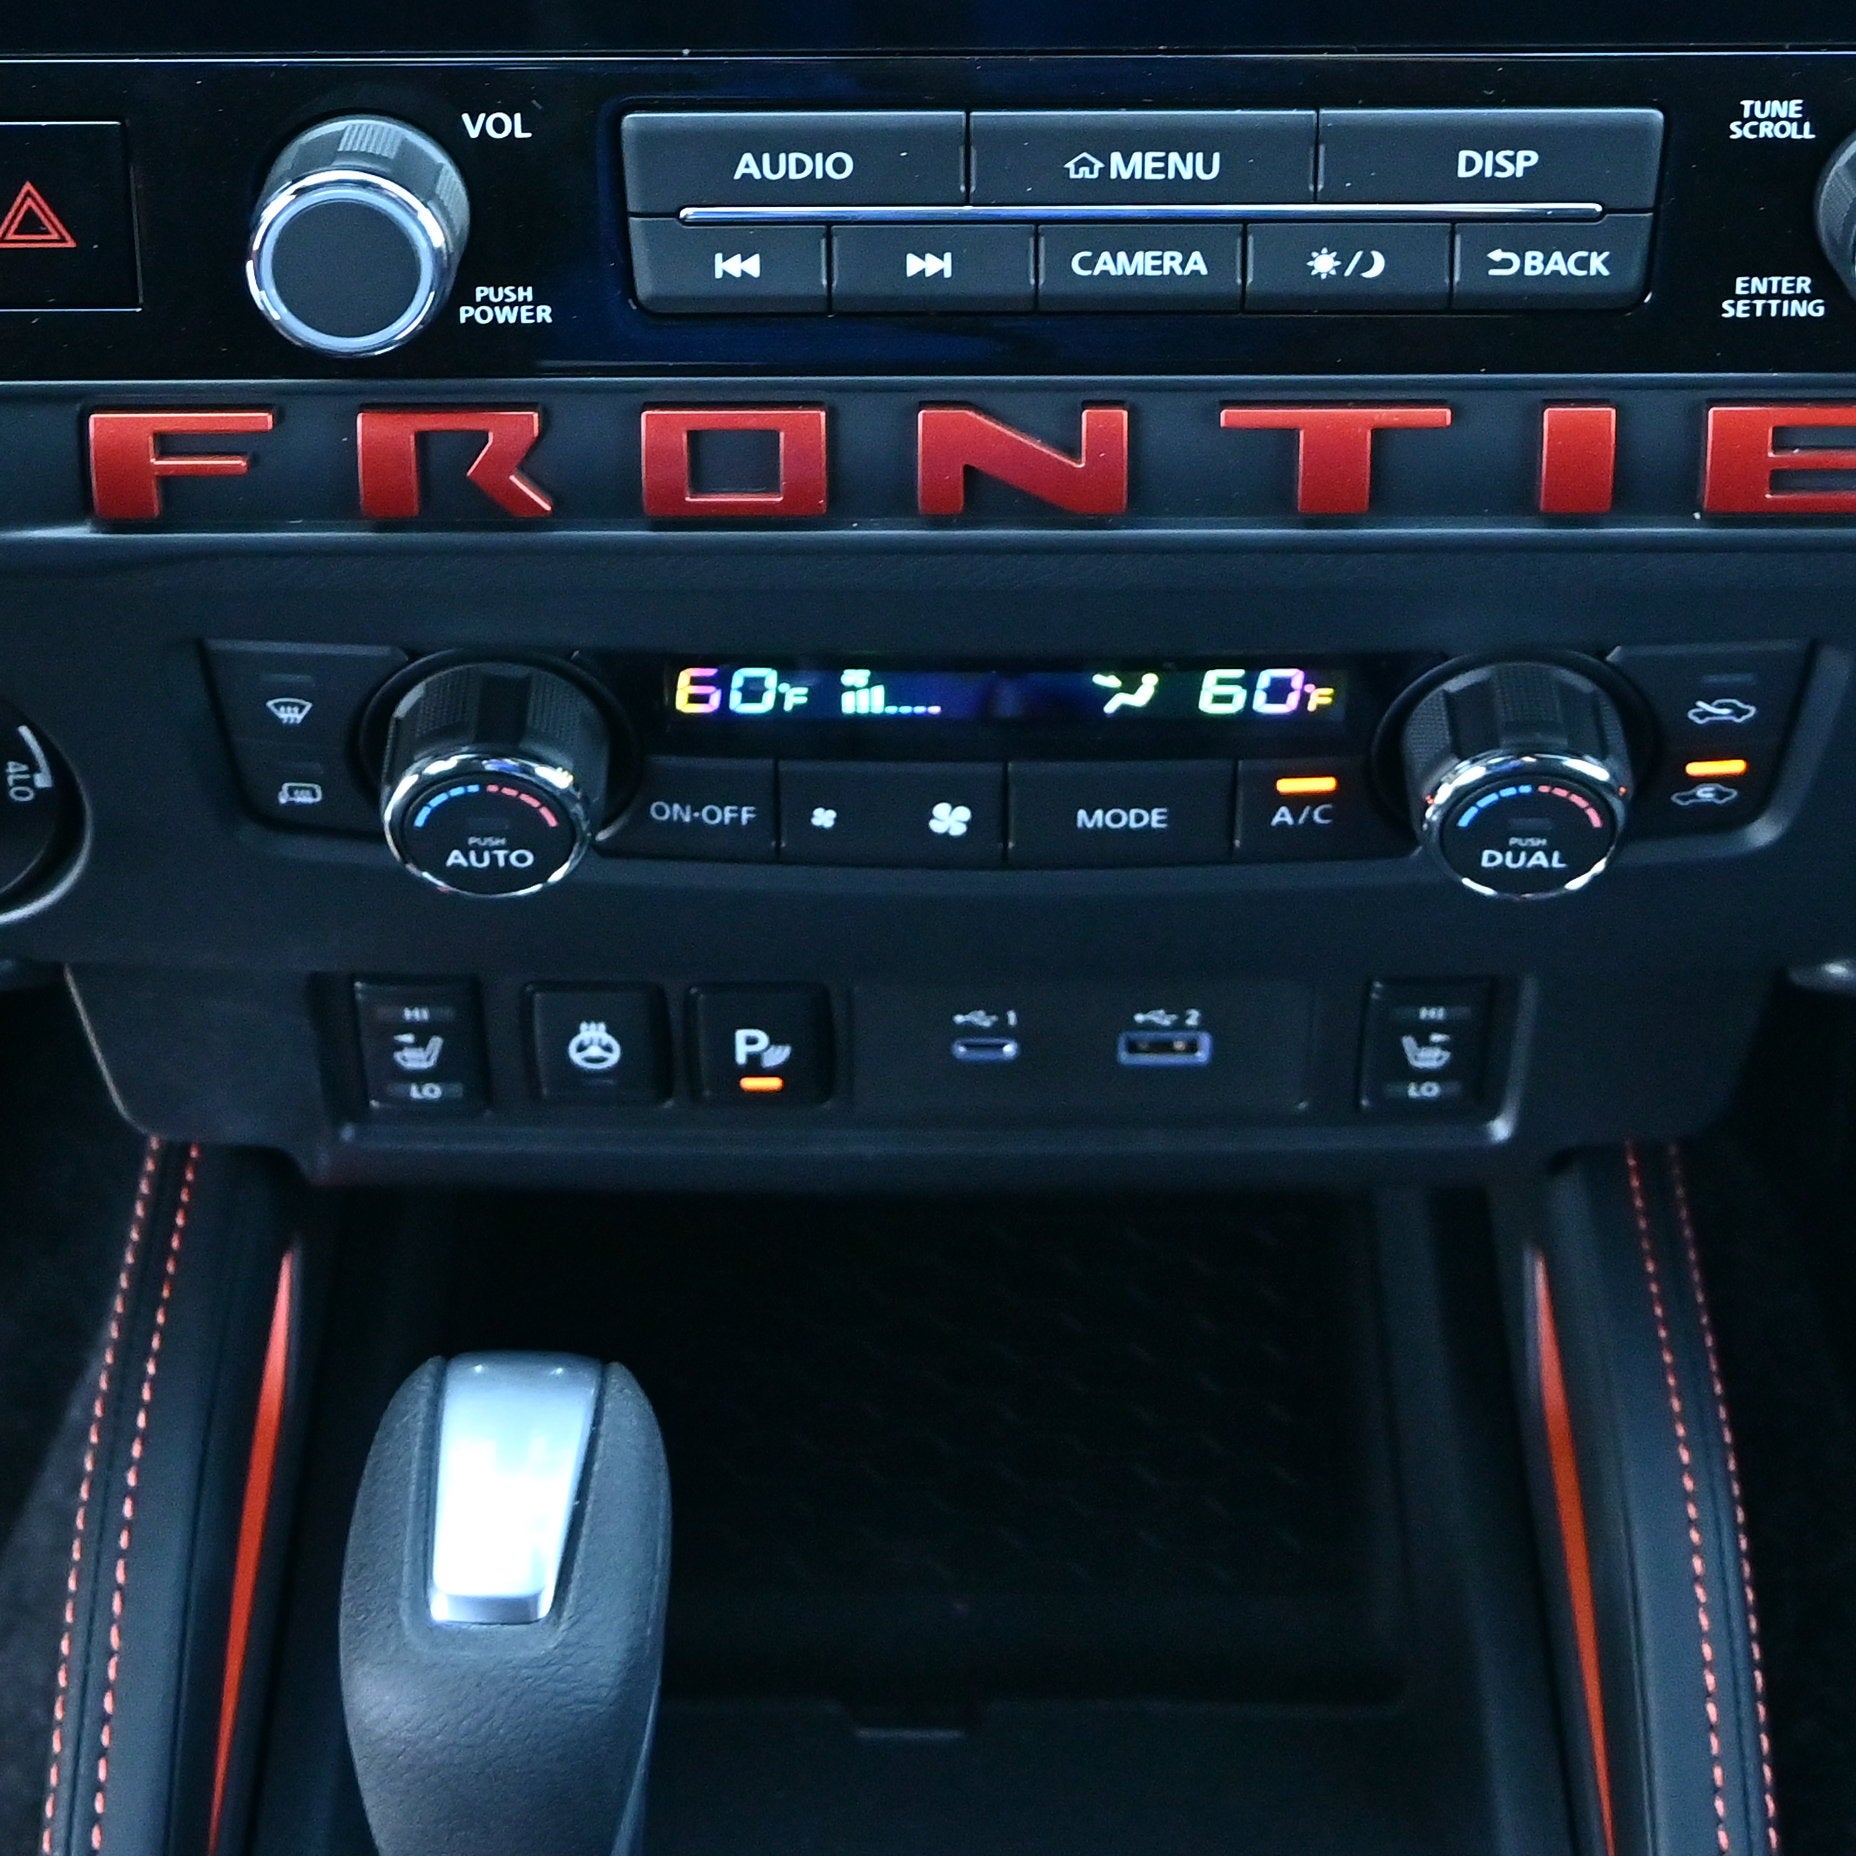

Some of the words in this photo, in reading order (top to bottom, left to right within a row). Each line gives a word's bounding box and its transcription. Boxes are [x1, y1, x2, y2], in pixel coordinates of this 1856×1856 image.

[1741, 99, 1803, 119] TUNE
[462, 112, 532, 140] VOL
[1729, 120, 1816, 141] SCROLL
[733, 151, 854, 181] AUDIO
[1110, 151, 1221, 181] MENU
[1456, 150, 1539, 179] DISP
[1070, 250, 1208, 277] CAMERA
[1523, 250, 1611, 277] BACK
[474, 285, 533, 304] PUSH
[1734, 276, 1811, 295] ENTER
[459, 305, 553, 325] POWER
[1721, 298, 1825, 319] SETTING
[5, 759, 36, 803] 4LO
[1076, 807, 1169, 831] MODE
[1270, 804, 1334, 827] A/C
[467, 836, 506, 847] PUSH
[1508, 836, 1547, 847] PUSH
[446, 849, 535, 869] AUTO
[1480, 849, 1567, 869] DUAL
[403, 1007, 430, 1022] HI
[1185, 1009, 1202, 1027] 2
[734, 1028, 770, 1065] P
[409, 1082, 442, 1100] LO
[1407, 1081, 1441, 1098] LO
